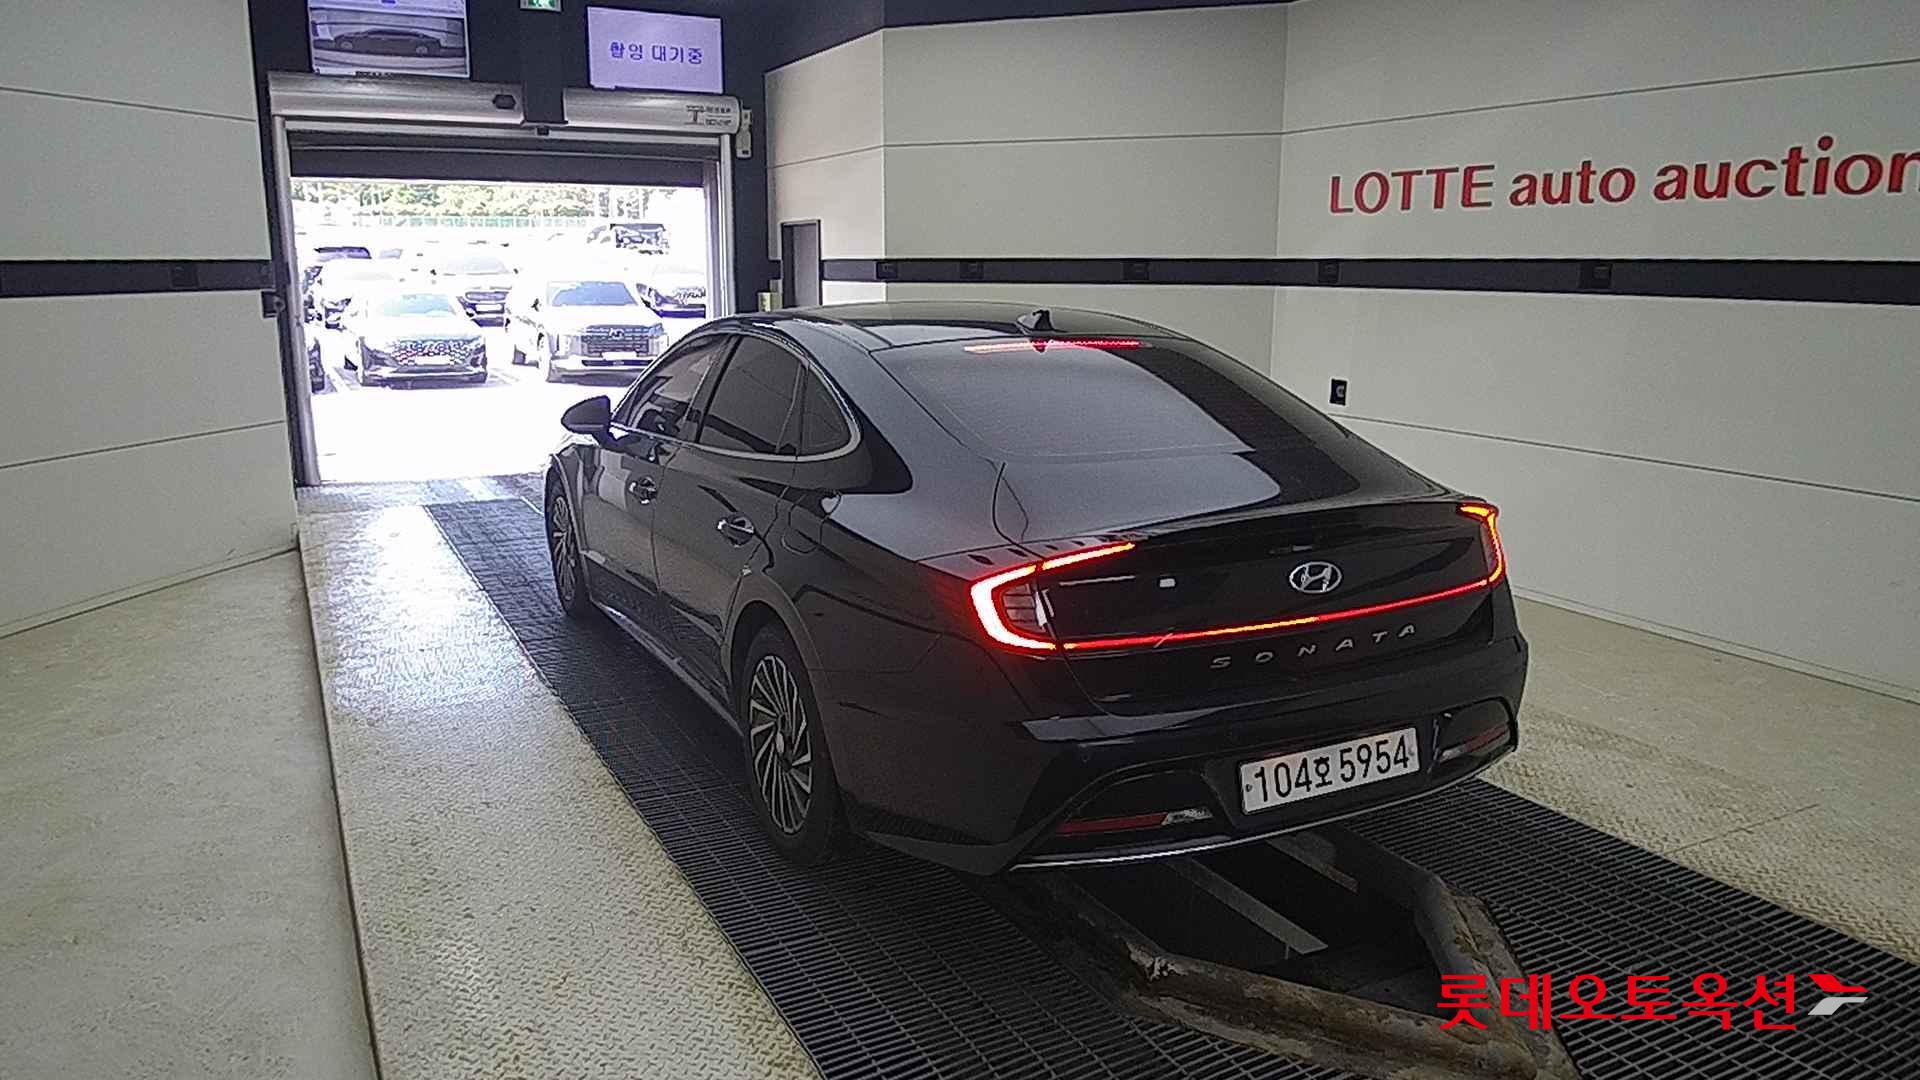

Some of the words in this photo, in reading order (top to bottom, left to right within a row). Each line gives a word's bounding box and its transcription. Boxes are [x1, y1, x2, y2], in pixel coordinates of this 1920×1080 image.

[610, 42, 643, 60] 촬영
[652, 45, 702, 64] 대기중
[1330, 165, 1495, 213] LOTTE
[1510, 160, 1636, 207] auto
[1653, 135, 1920, 201] auction
[1210, 624, 1415, 669] SONATA
